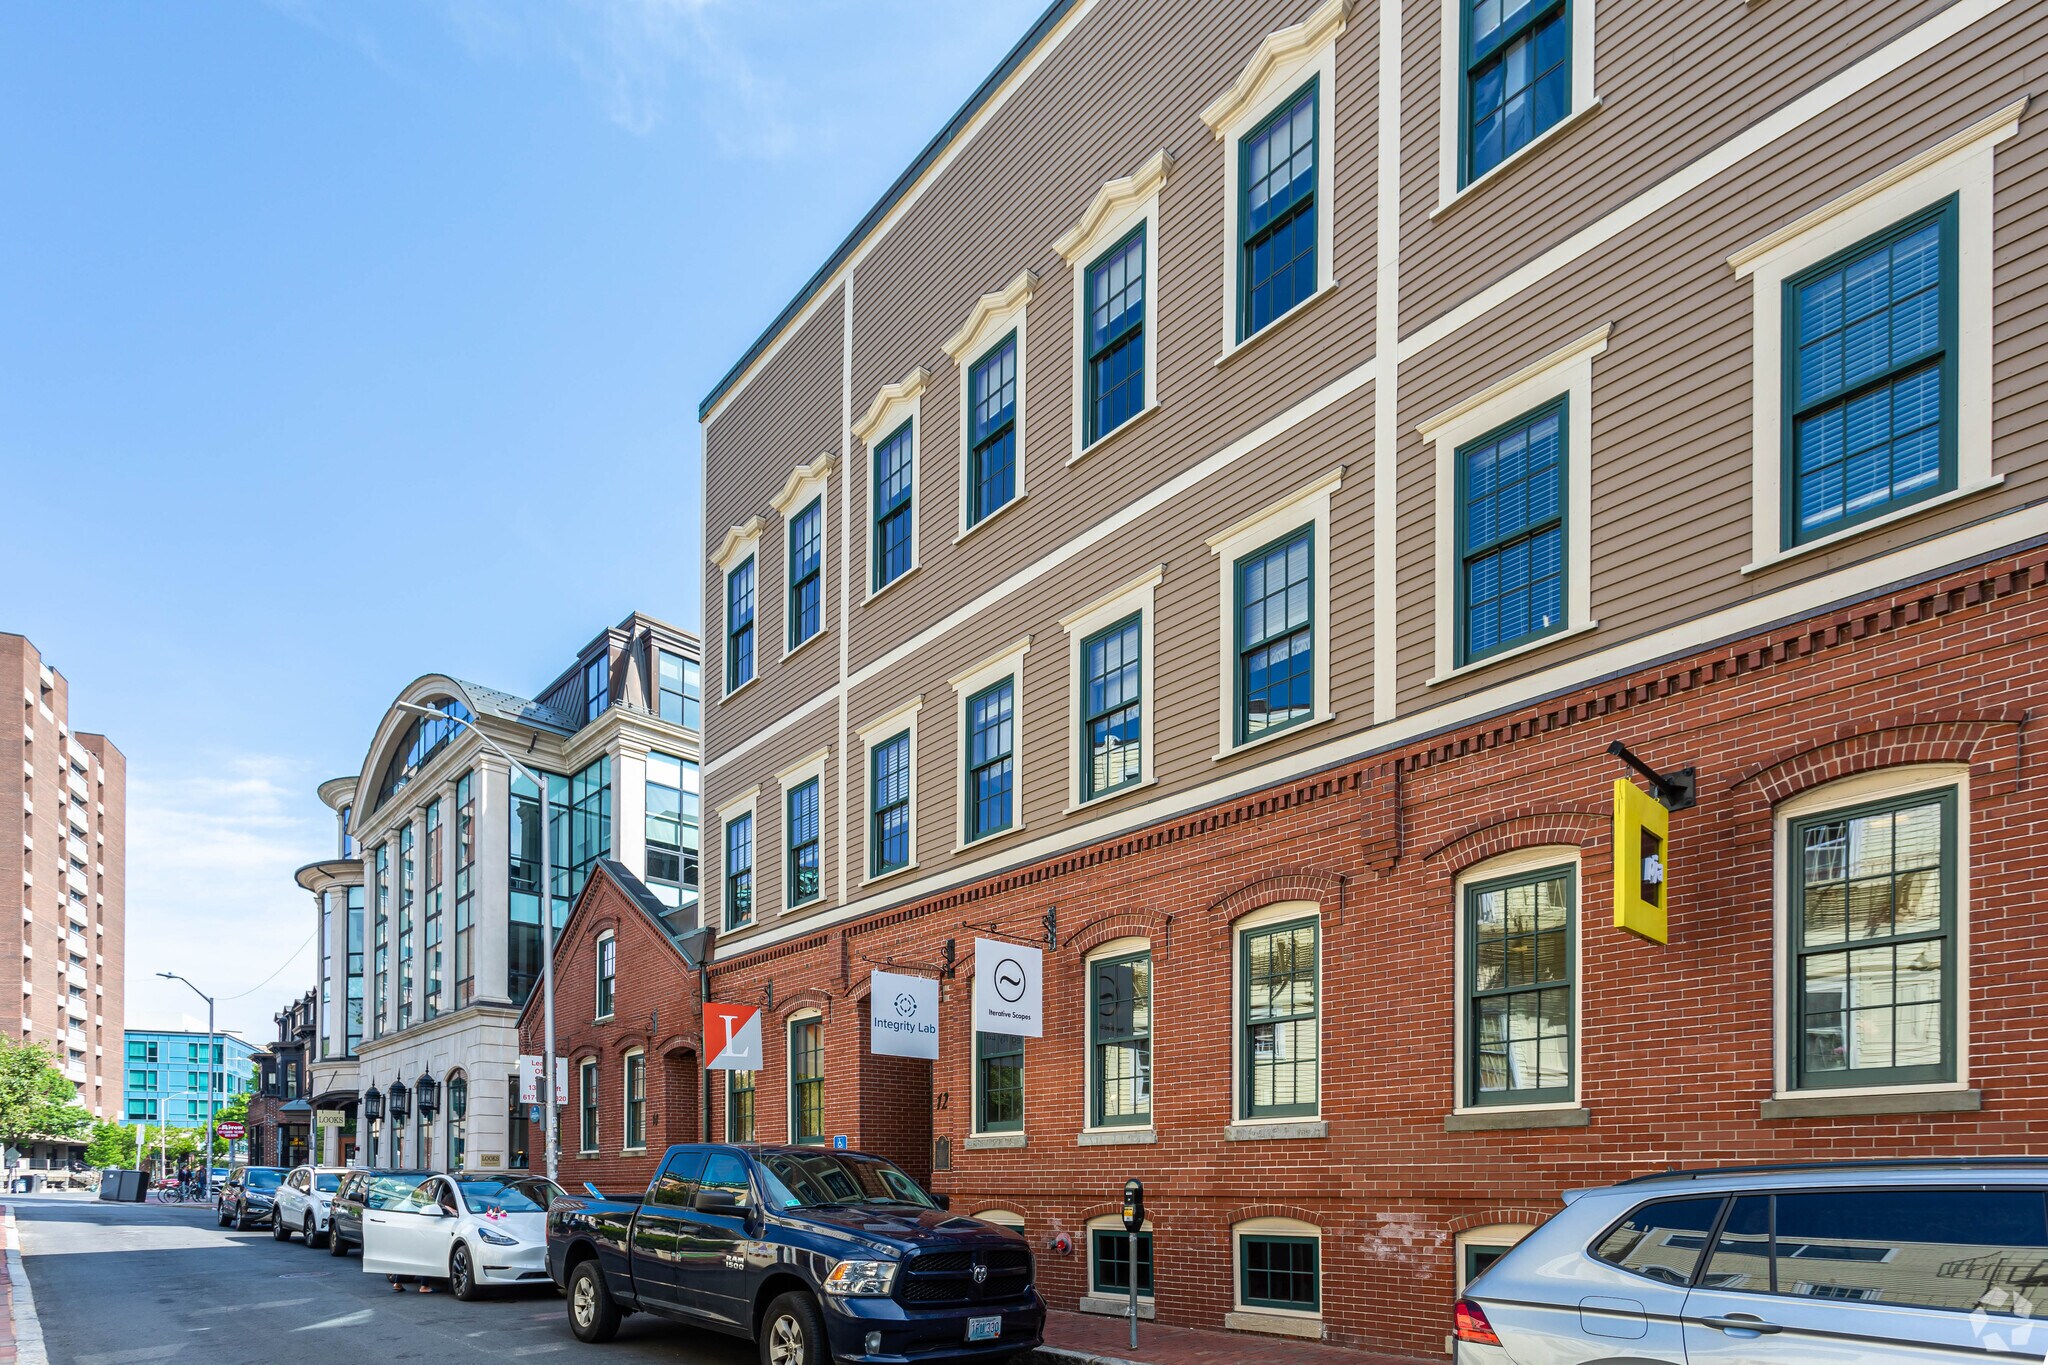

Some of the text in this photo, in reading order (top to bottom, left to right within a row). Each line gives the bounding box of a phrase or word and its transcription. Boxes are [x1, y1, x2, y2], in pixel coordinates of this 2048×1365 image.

[988, 1008, 1031, 1021] Iterative Scopes
[874, 1017, 936, 1034] Integrity Lab
[718, 1015, 749, 1057] L
[937, 1092, 949, 1110] 12
[318, 1116, 344, 1124] LOOKS
[726, 1254, 745, 1264] RAM
[725, 1261, 745, 1271] 1500
